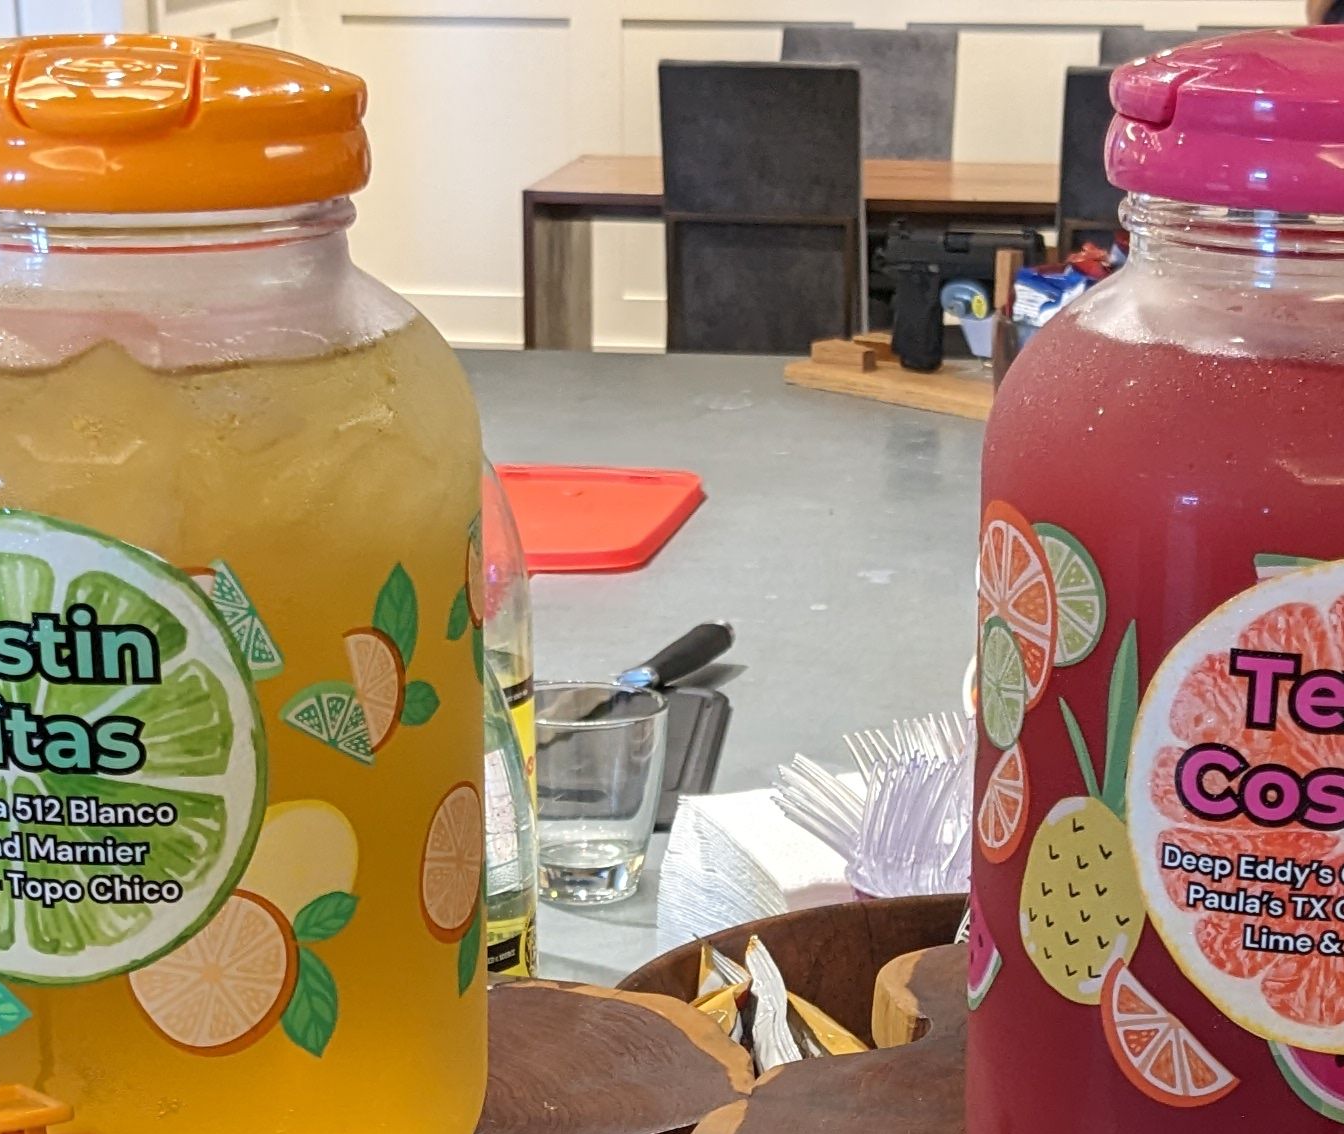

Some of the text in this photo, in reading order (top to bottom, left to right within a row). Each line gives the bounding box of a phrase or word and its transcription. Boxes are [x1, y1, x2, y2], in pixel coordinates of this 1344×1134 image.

[13, 796, 63, 823] 512
[70, 797, 175, 826] Blanco
[28, 835, 149, 865] Marnier
[1162, 843, 1231, 880] Deep
[1238, 855, 1334, 889] Eddy's
[7, 872, 82, 908] Topo
[88, 876, 182, 902] Chico
[1187, 883, 1282, 917] Paula's
[1290, 896, 1329, 921] TX
[1242, 926, 1312, 954] Lime
[1319, 933, 1343, 955] &
